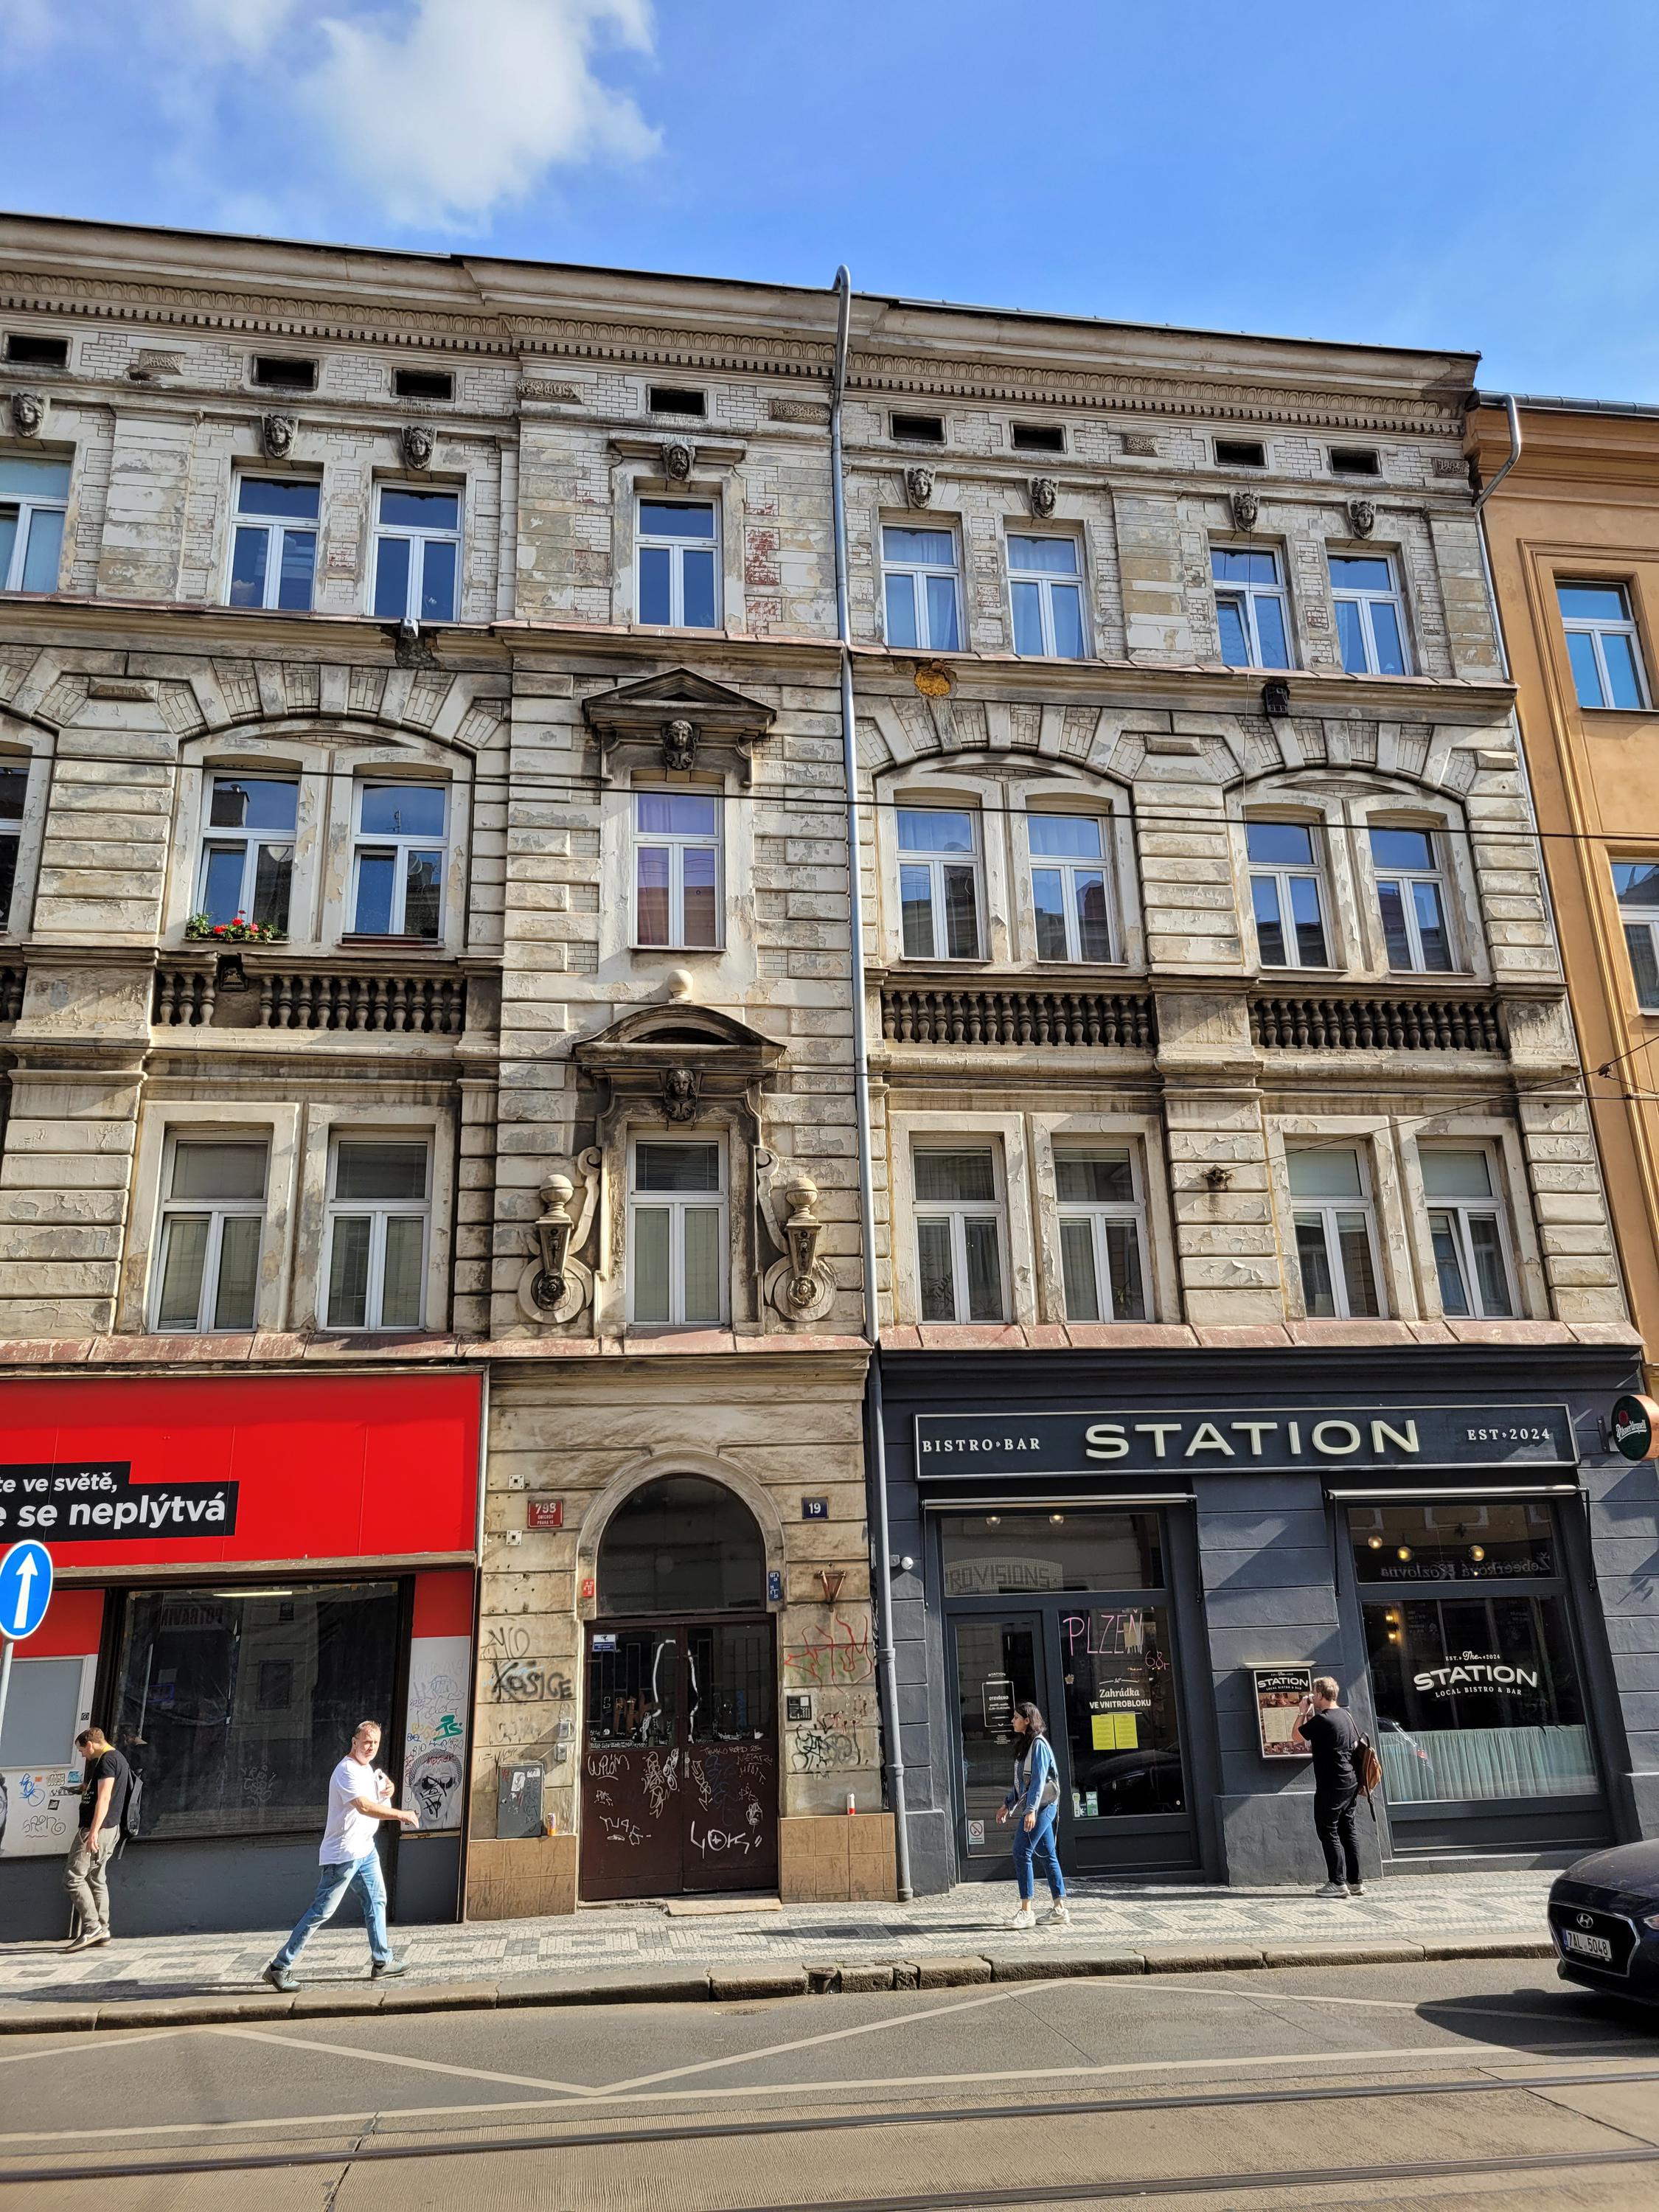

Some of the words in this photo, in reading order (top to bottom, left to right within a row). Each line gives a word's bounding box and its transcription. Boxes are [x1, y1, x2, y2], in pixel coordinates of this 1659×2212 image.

[1085, 1420, 1419, 1458] STATION
[1467, 1429, 1498, 1440] EST
[1509, 1428, 1550, 1440] 2024
[922, 1439, 992, 1453] BISTRO
[1004, 1438, 1040, 1450] BAR
[23, 1478, 49, 1492] ve
[54, 1472, 117, 1493] světě,
[17, 1503, 58, 1527] se
[69, 1492, 225, 1529] neplýtvá
[535, 1502, 556, 1514] 798
[808, 1503, 821, 1514] 19
[1462, 1651, 1481, 1660] The
[1257, 1677, 1309, 1688] STATION
[1413, 1665, 1538, 1691] STATION
[1099, 1688, 1140, 1698] Zahrádka
[1436, 1688, 1461, 1697] LOCAL
[1506, 1687, 1522, 1695] BAR
[1099, 1699, 1152, 1708] VNITROBLOKU
[1568, 1933, 1582, 1949] 7AL
[1587, 1938, 1608, 1955] 5048
